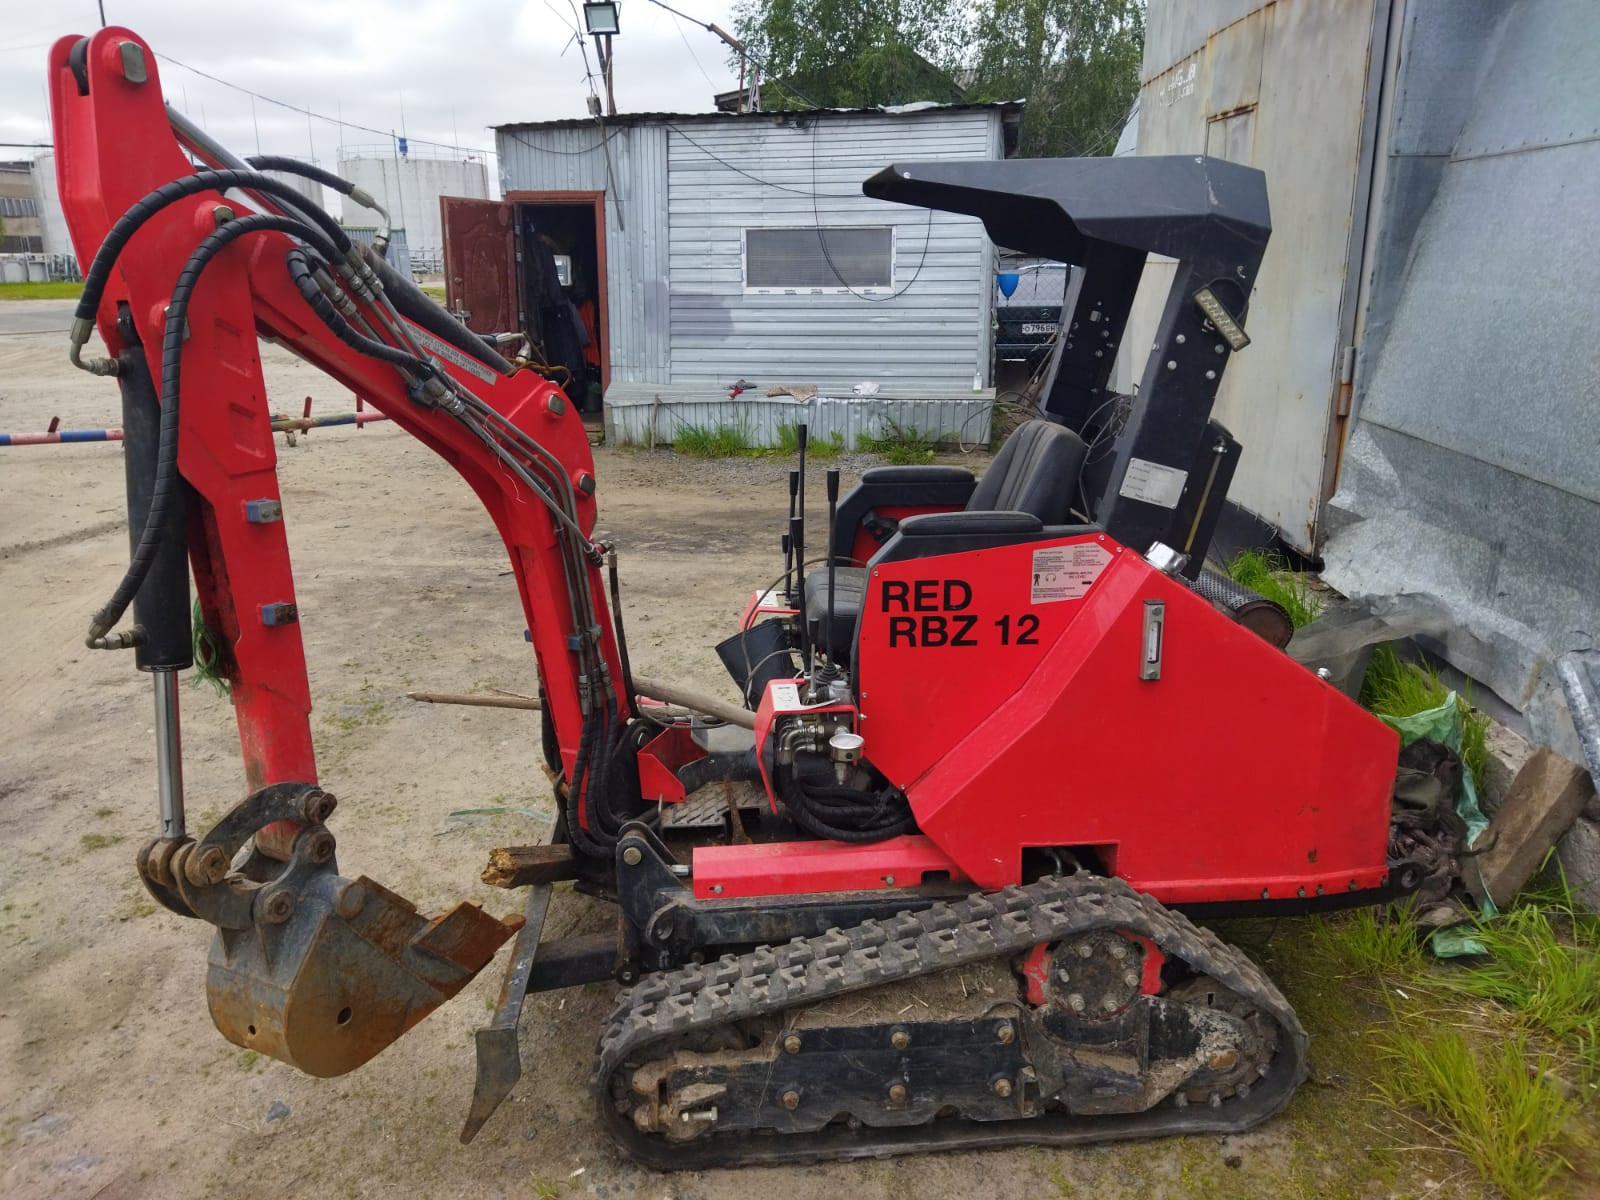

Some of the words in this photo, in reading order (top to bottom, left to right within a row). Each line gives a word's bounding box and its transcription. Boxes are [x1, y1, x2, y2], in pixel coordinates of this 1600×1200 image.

[882, 580, 972, 612] RED
[890, 615, 978, 648] RBZ
[995, 614, 1040, 645] 12
